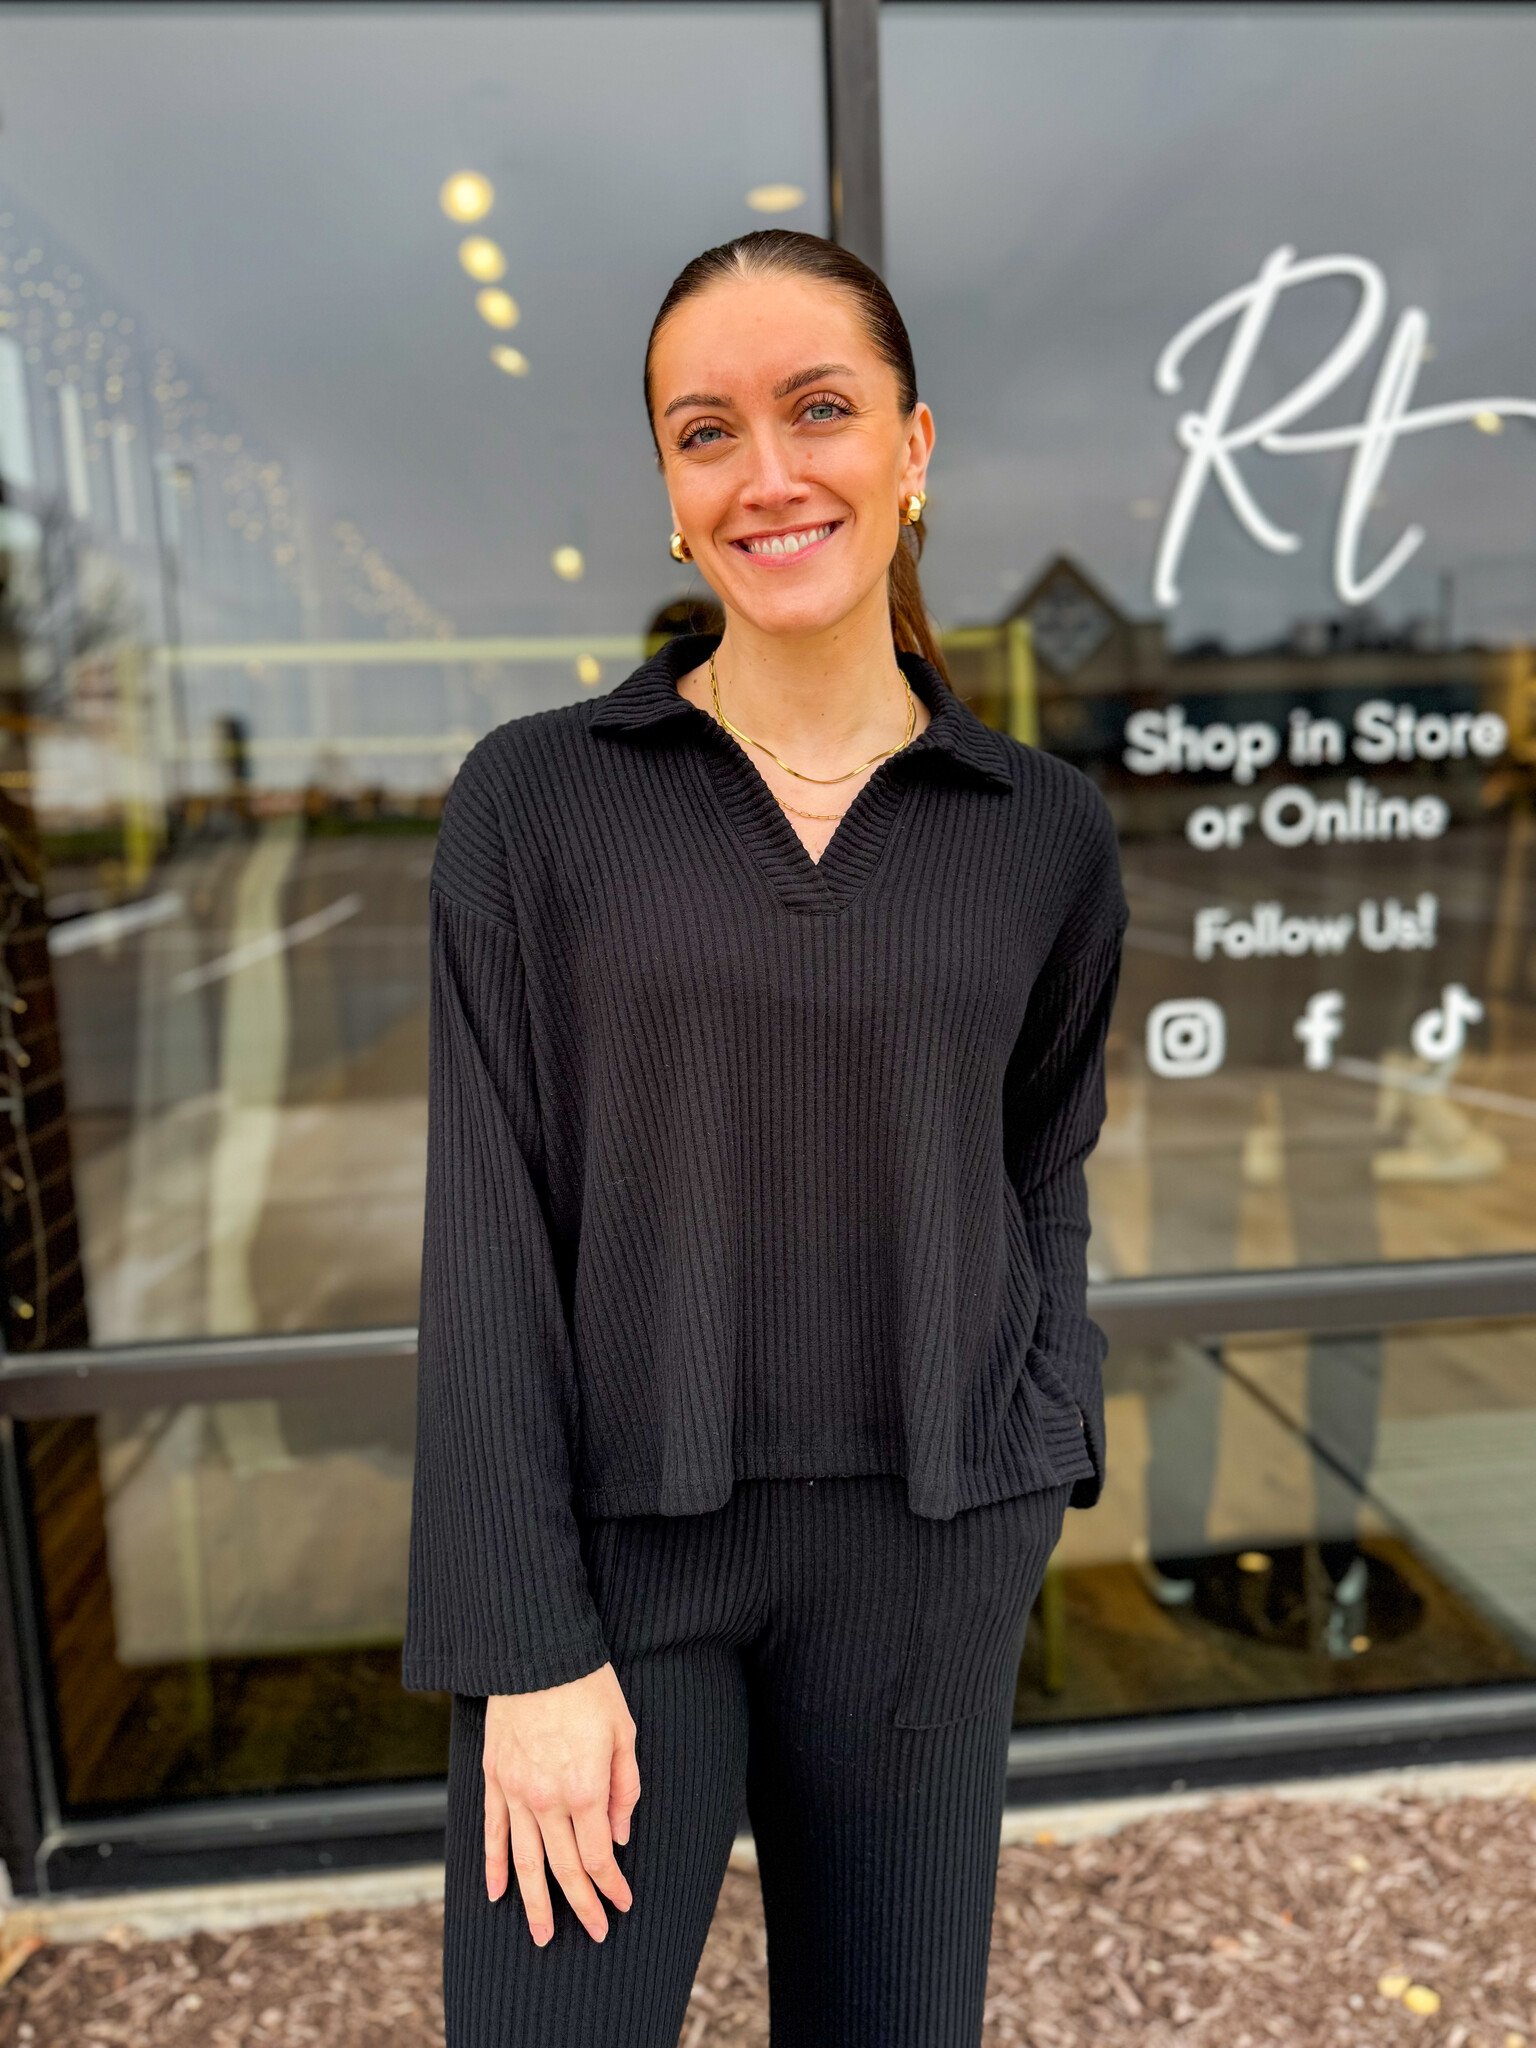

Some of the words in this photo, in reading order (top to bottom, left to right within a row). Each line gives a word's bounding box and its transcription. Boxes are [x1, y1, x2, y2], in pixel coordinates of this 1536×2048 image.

[1124, 706, 1279, 784] Shop
[1288, 708, 1345, 766] in
[1353, 700, 1507, 763] Store
[1187, 803, 1254, 851] or
[1261, 778, 1449, 847] Online
[1193, 902, 1354, 961] Follow
[1359, 893, 1437, 951] Us!
